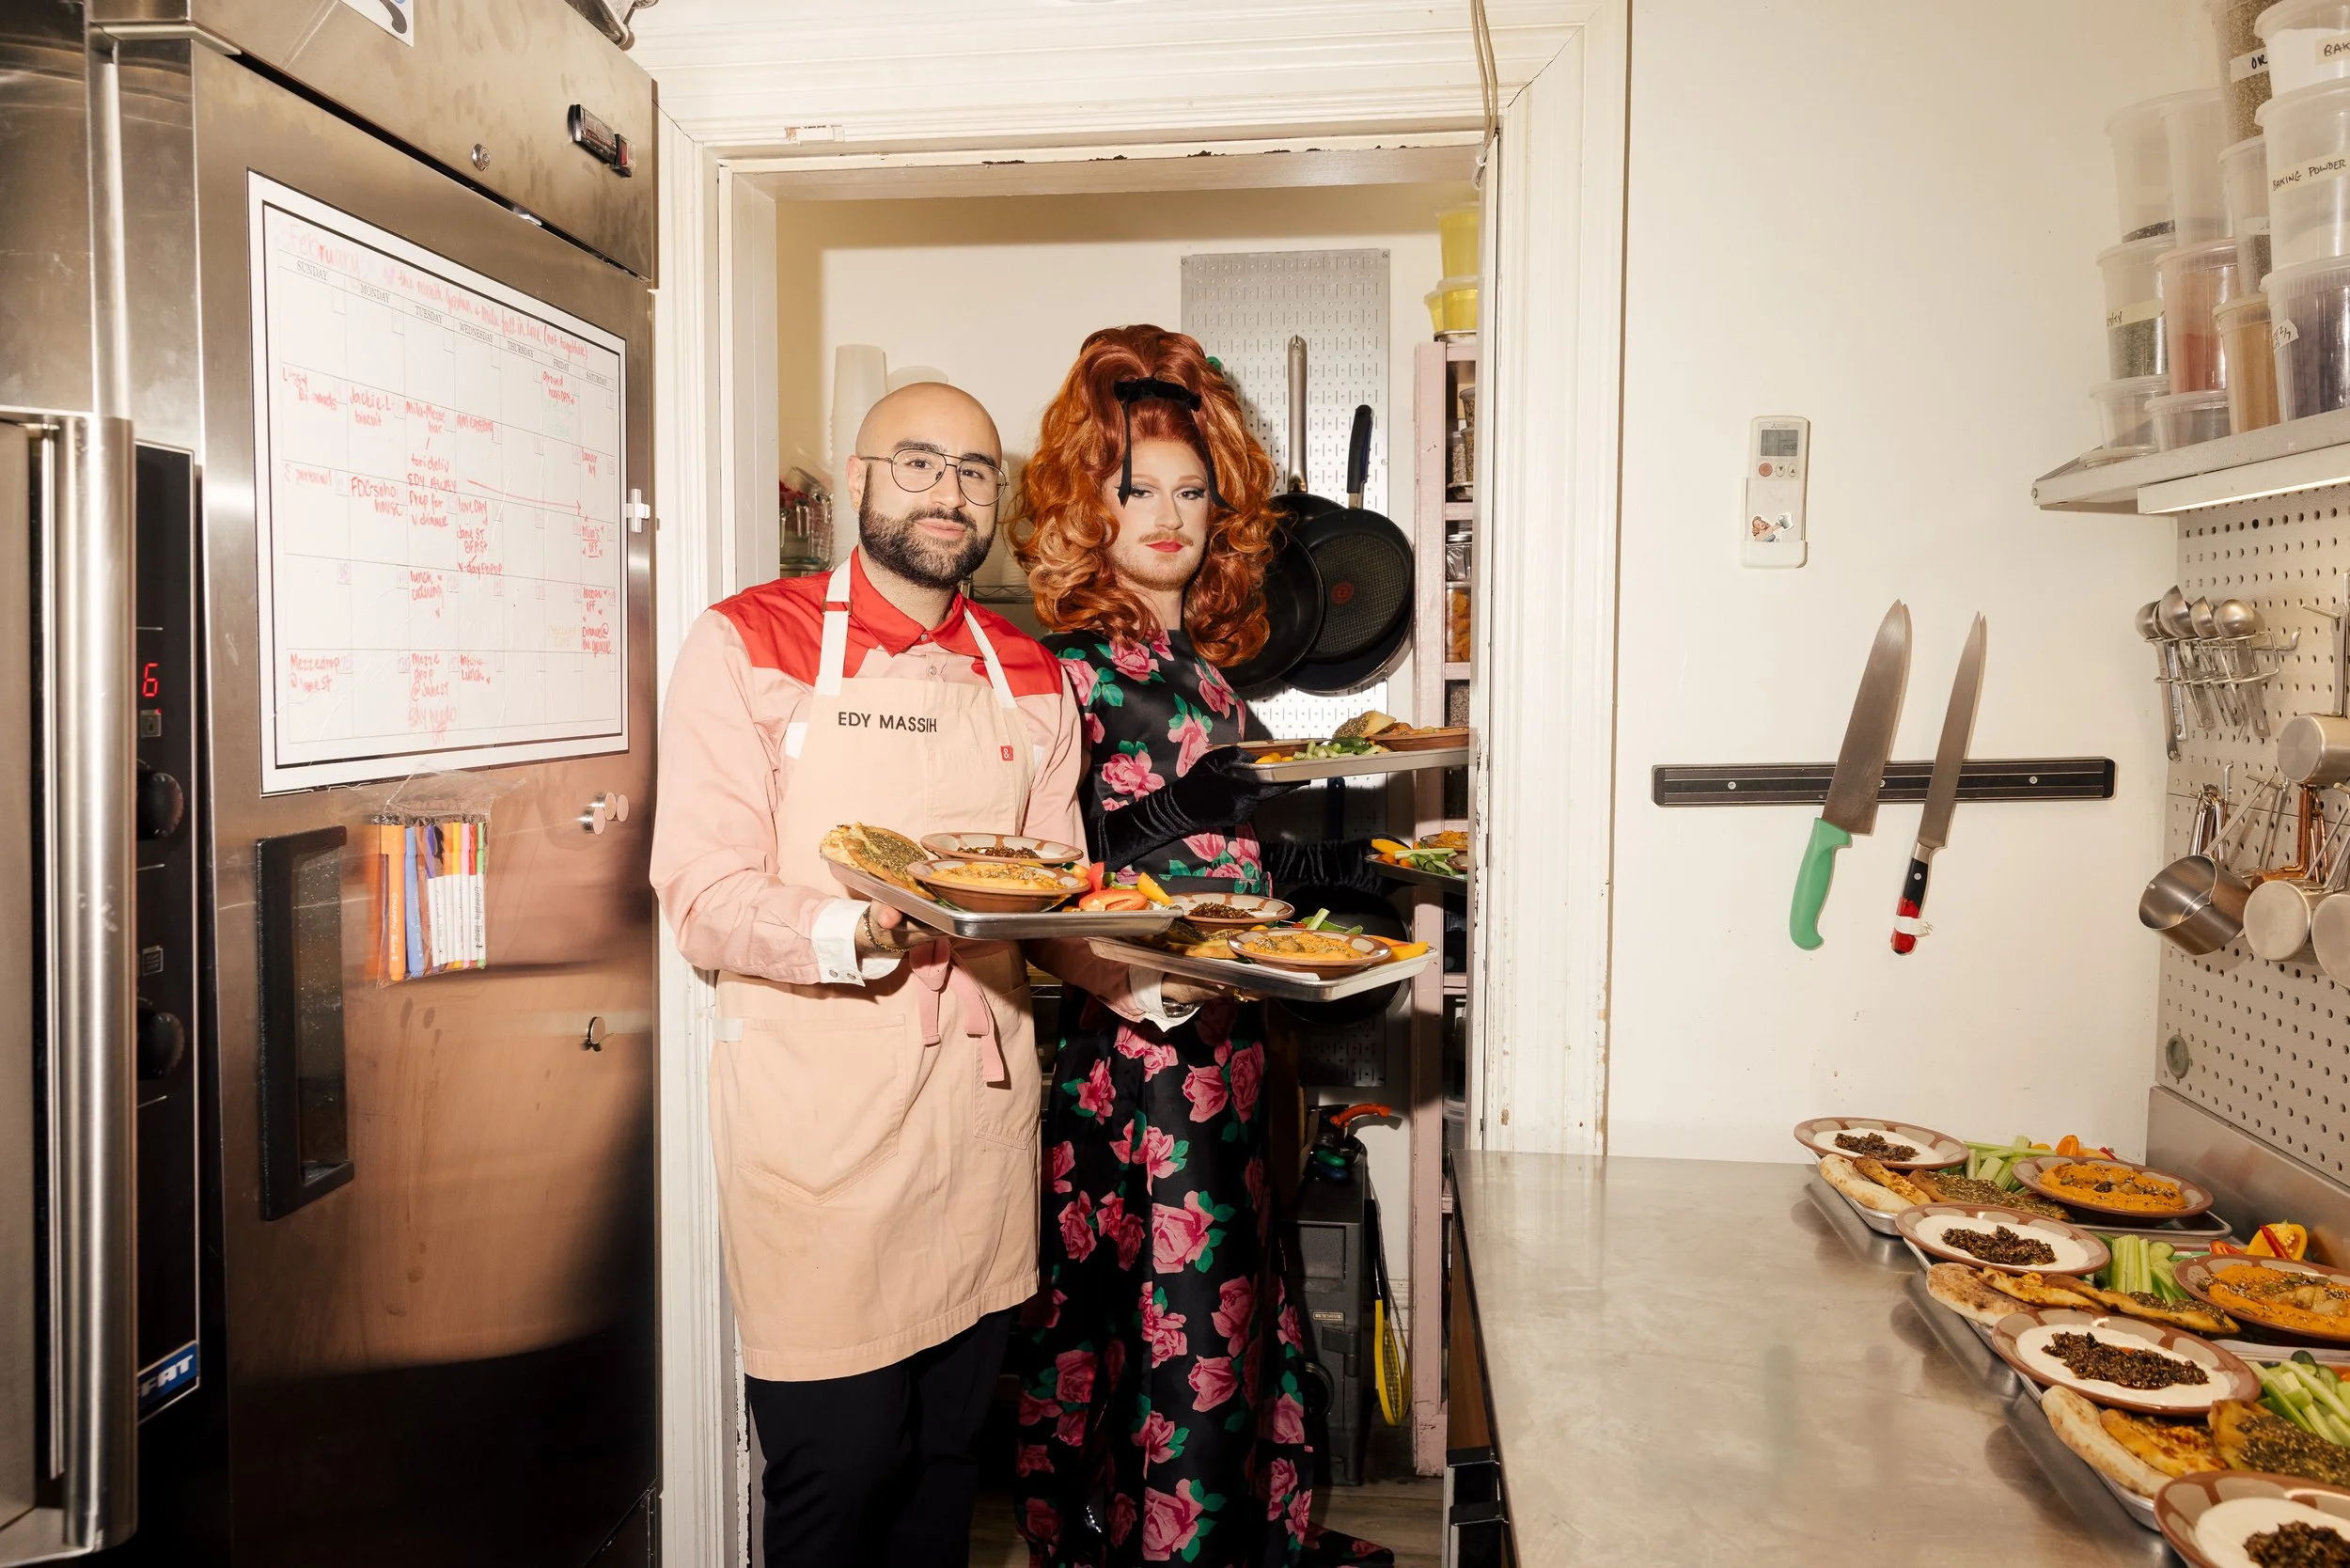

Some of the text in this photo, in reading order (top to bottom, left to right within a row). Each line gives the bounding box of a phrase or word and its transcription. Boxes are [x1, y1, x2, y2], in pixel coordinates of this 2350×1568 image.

[2272, 158, 2347, 192] BAKING POWDER
[296, 260, 328, 281] SUNDAY
[360, 283, 390, 303] MONDAY
[415, 306, 443, 323] TUESDAY
[459, 322, 494, 343] WEDNESDAY
[507, 340, 535, 358] THURSDAY
[553, 358, 571, 372] FRIDAY
[586, 371, 608, 387] SATURDAY
[142, 662, 160, 698] 6
[838, 711, 938, 733] EDY MASSIH
